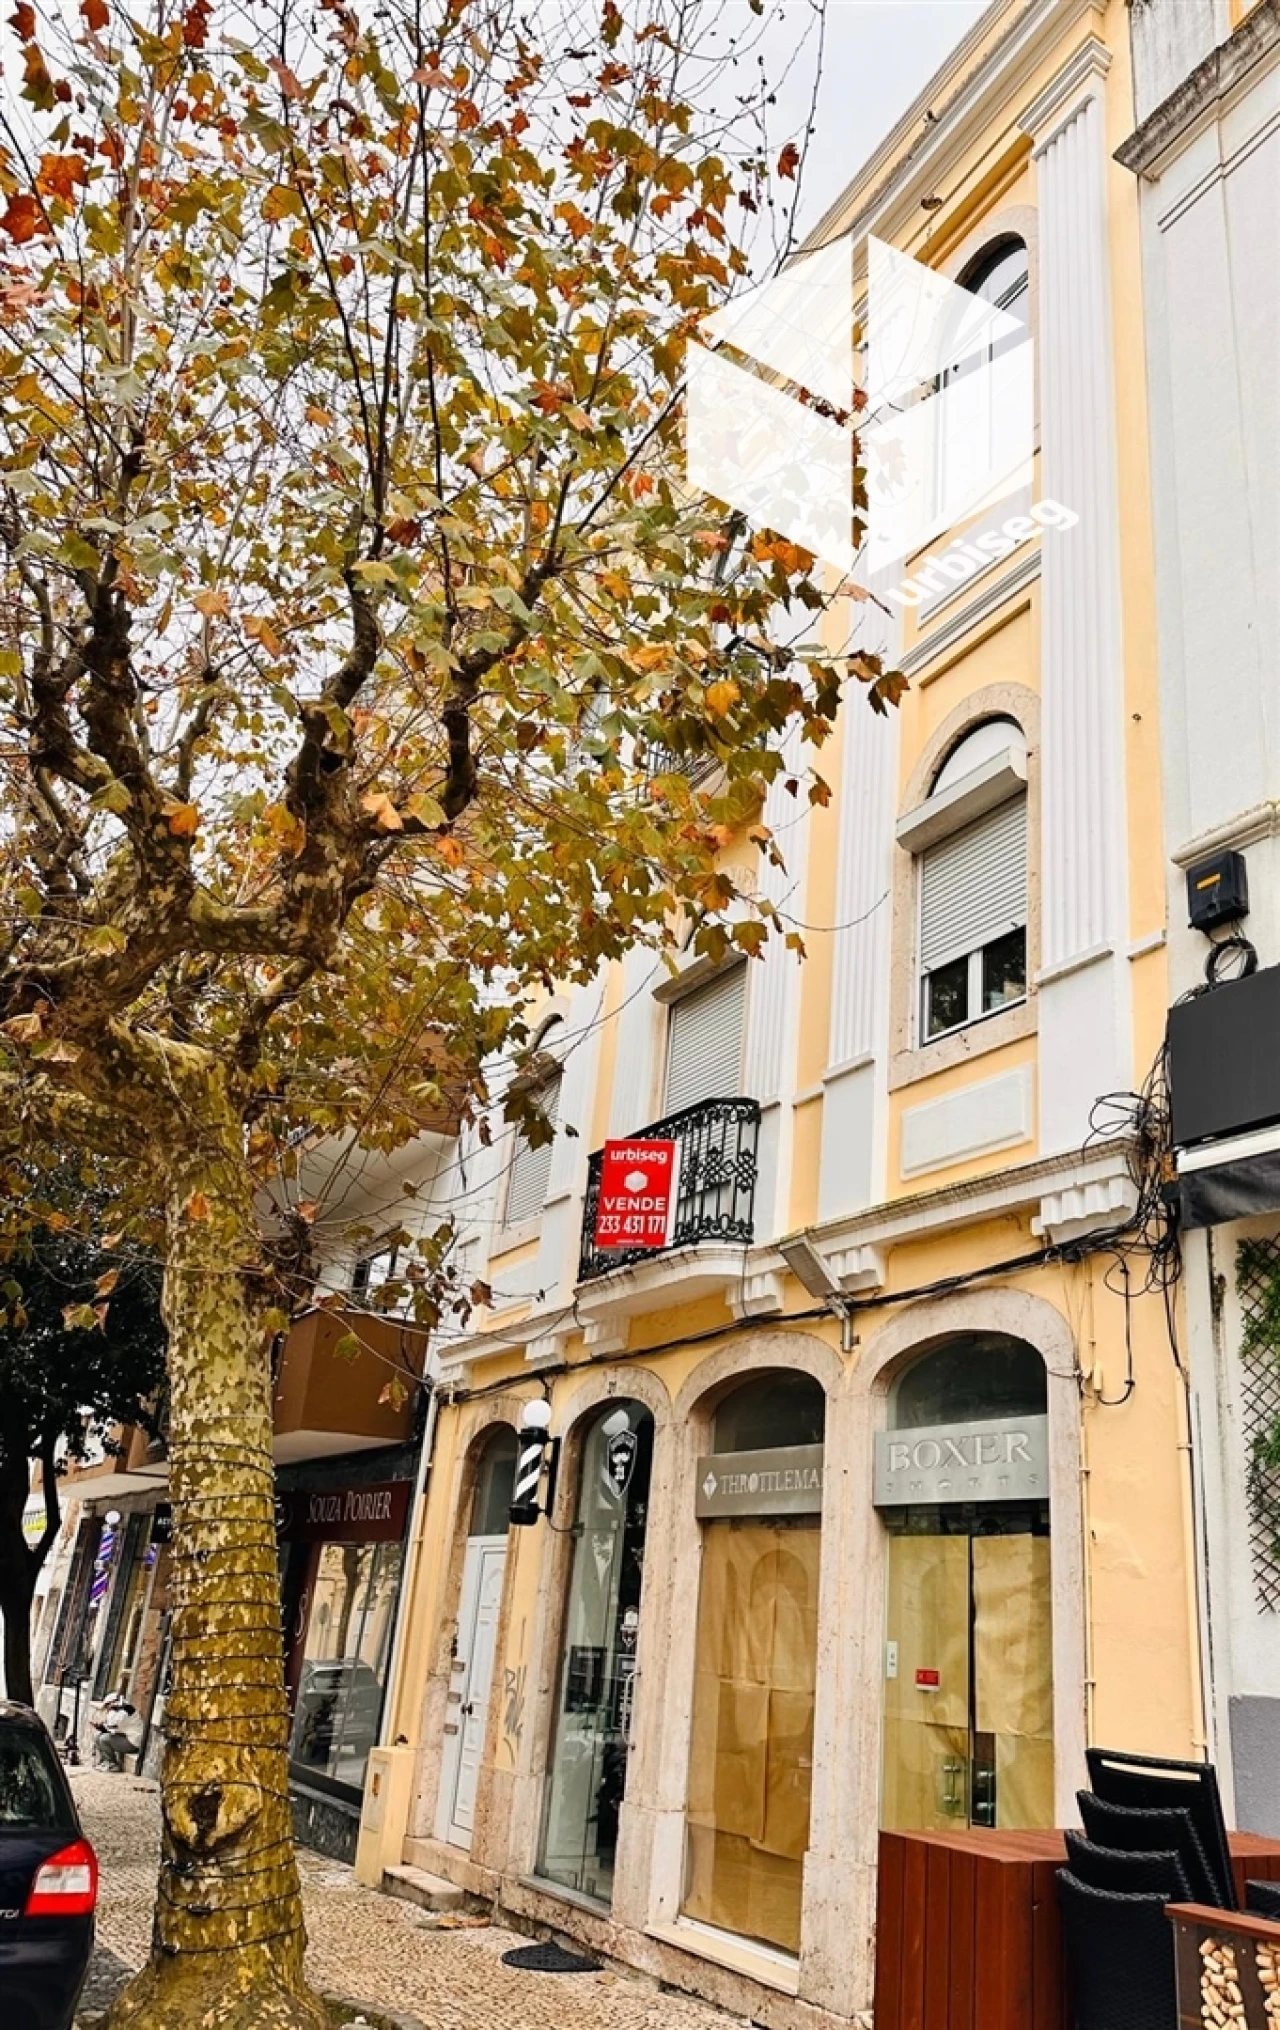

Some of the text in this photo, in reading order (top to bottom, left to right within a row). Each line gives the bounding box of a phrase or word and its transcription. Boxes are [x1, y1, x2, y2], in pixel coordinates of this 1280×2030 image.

[610, 1147, 668, 1164] urbiseg
[603, 1196, 666, 1211] VENDE
[598, 1215, 666, 1234] 233 431 171
[887, 1430, 1033, 1473] BOXER
[720, 1467, 823, 1495] THROTTLEMA
[306, 1490, 391, 1524] SOUZA POIRIER
